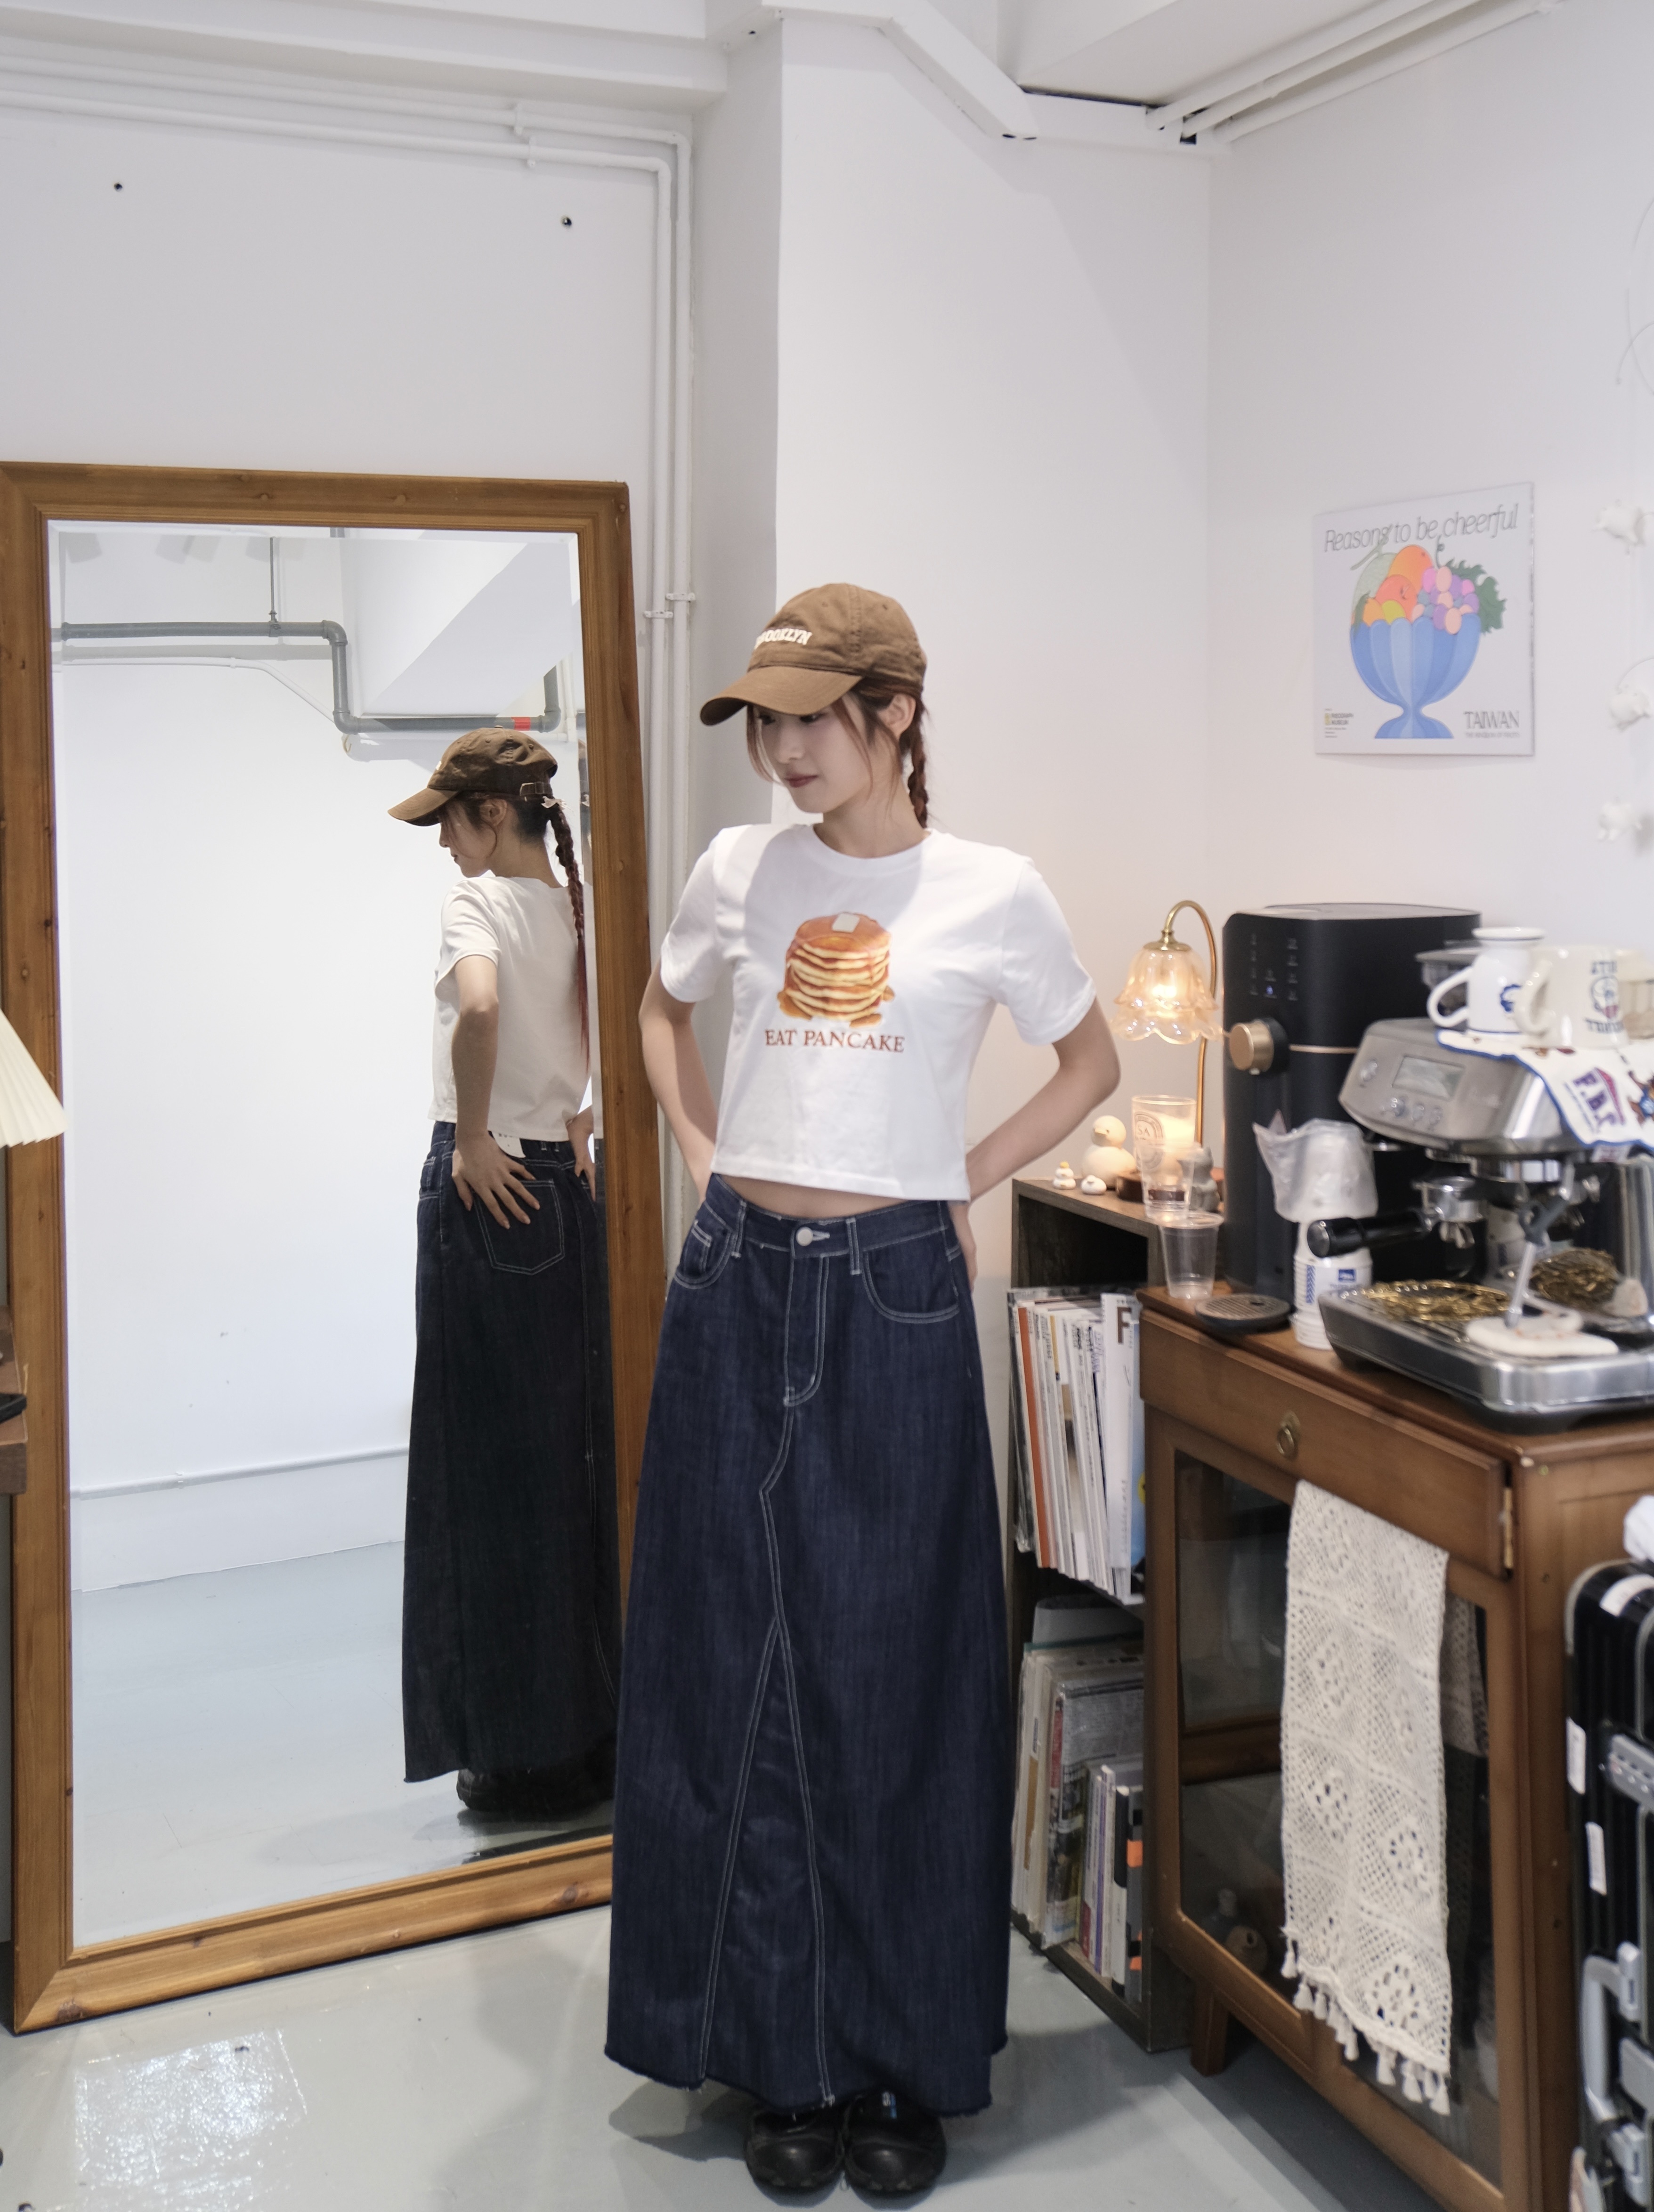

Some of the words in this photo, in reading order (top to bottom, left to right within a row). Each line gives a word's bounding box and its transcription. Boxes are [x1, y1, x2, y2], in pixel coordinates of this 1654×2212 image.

[1325, 525, 1391, 552] Reasons
[1395, 523, 1412, 543] to
[1415, 516, 1439, 541] be
[1442, 502, 1519, 539] cheerful
[1463, 710, 1519, 729] TAIWAN
[765, 1029, 798, 1046] EAT
[803, 1030, 905, 1053] PANCAKE
